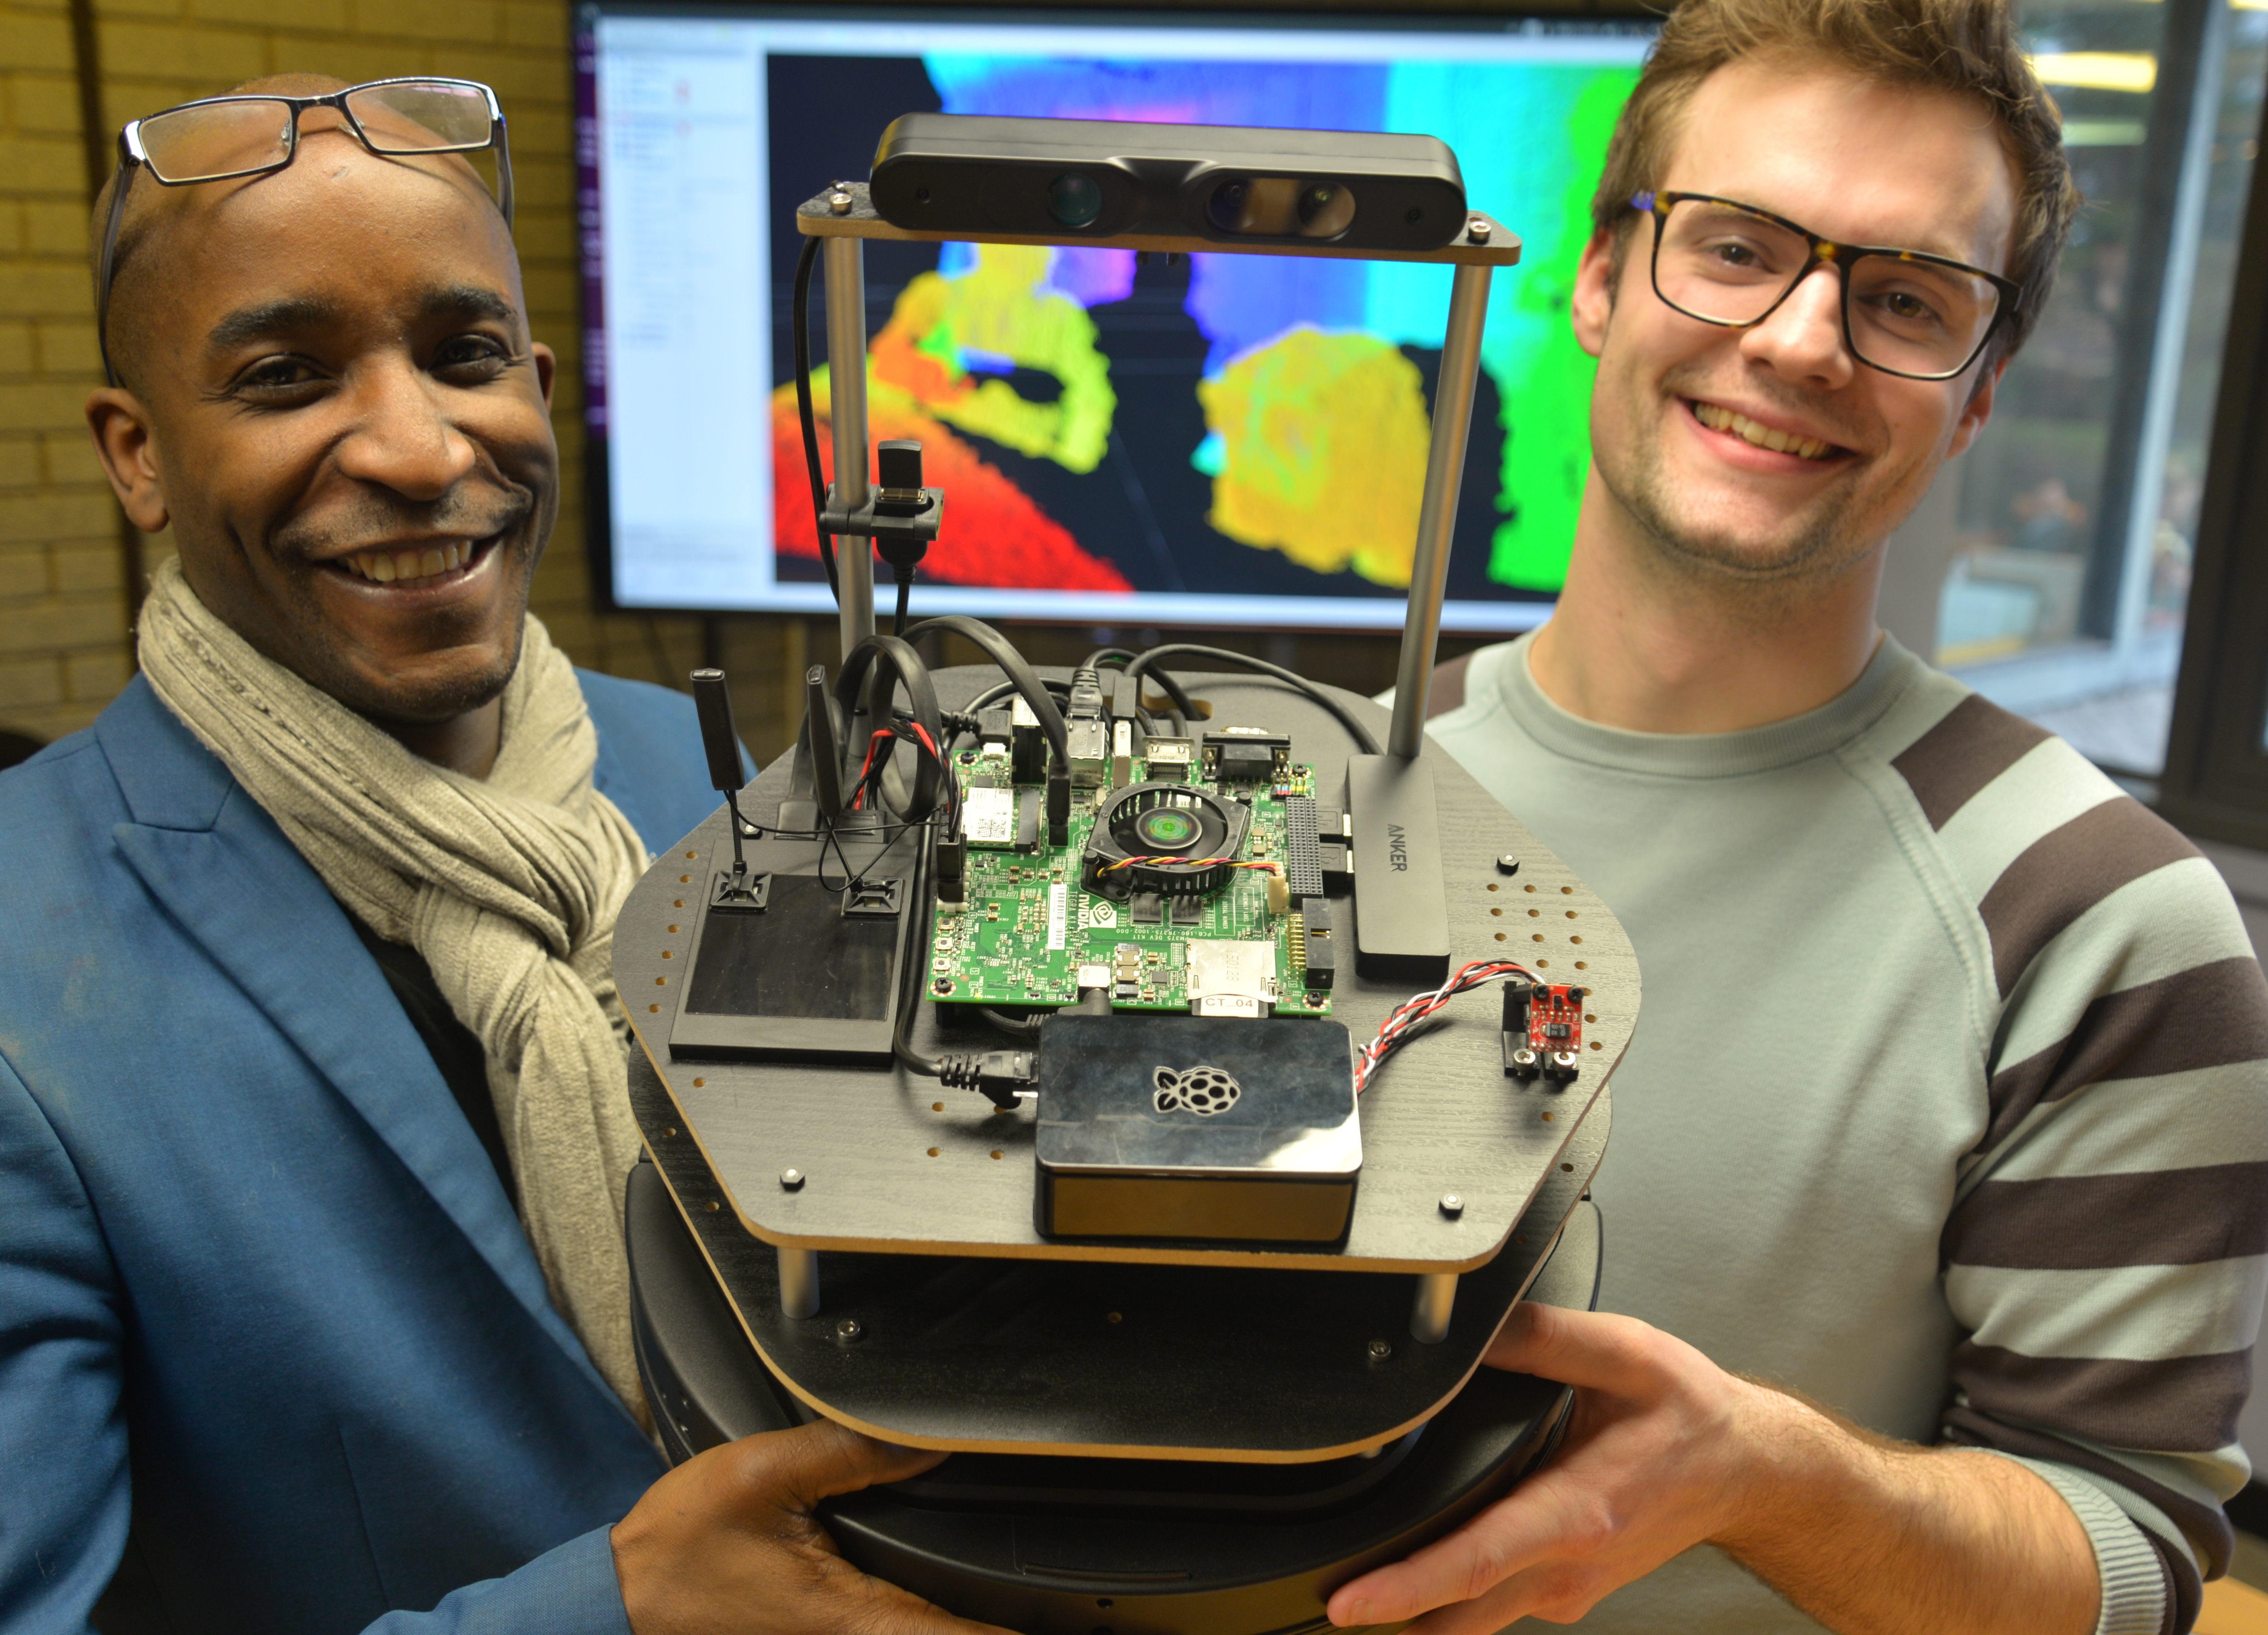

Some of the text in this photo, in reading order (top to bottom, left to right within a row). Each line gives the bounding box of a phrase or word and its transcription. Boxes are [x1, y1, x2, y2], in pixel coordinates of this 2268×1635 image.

[1388, 823, 1407, 872] ANKER
[1068, 891, 1077, 924] TEGRA K1
[1078, 894, 1090, 930] NVIDIA
[1205, 998, 1253, 1007] CT_04
